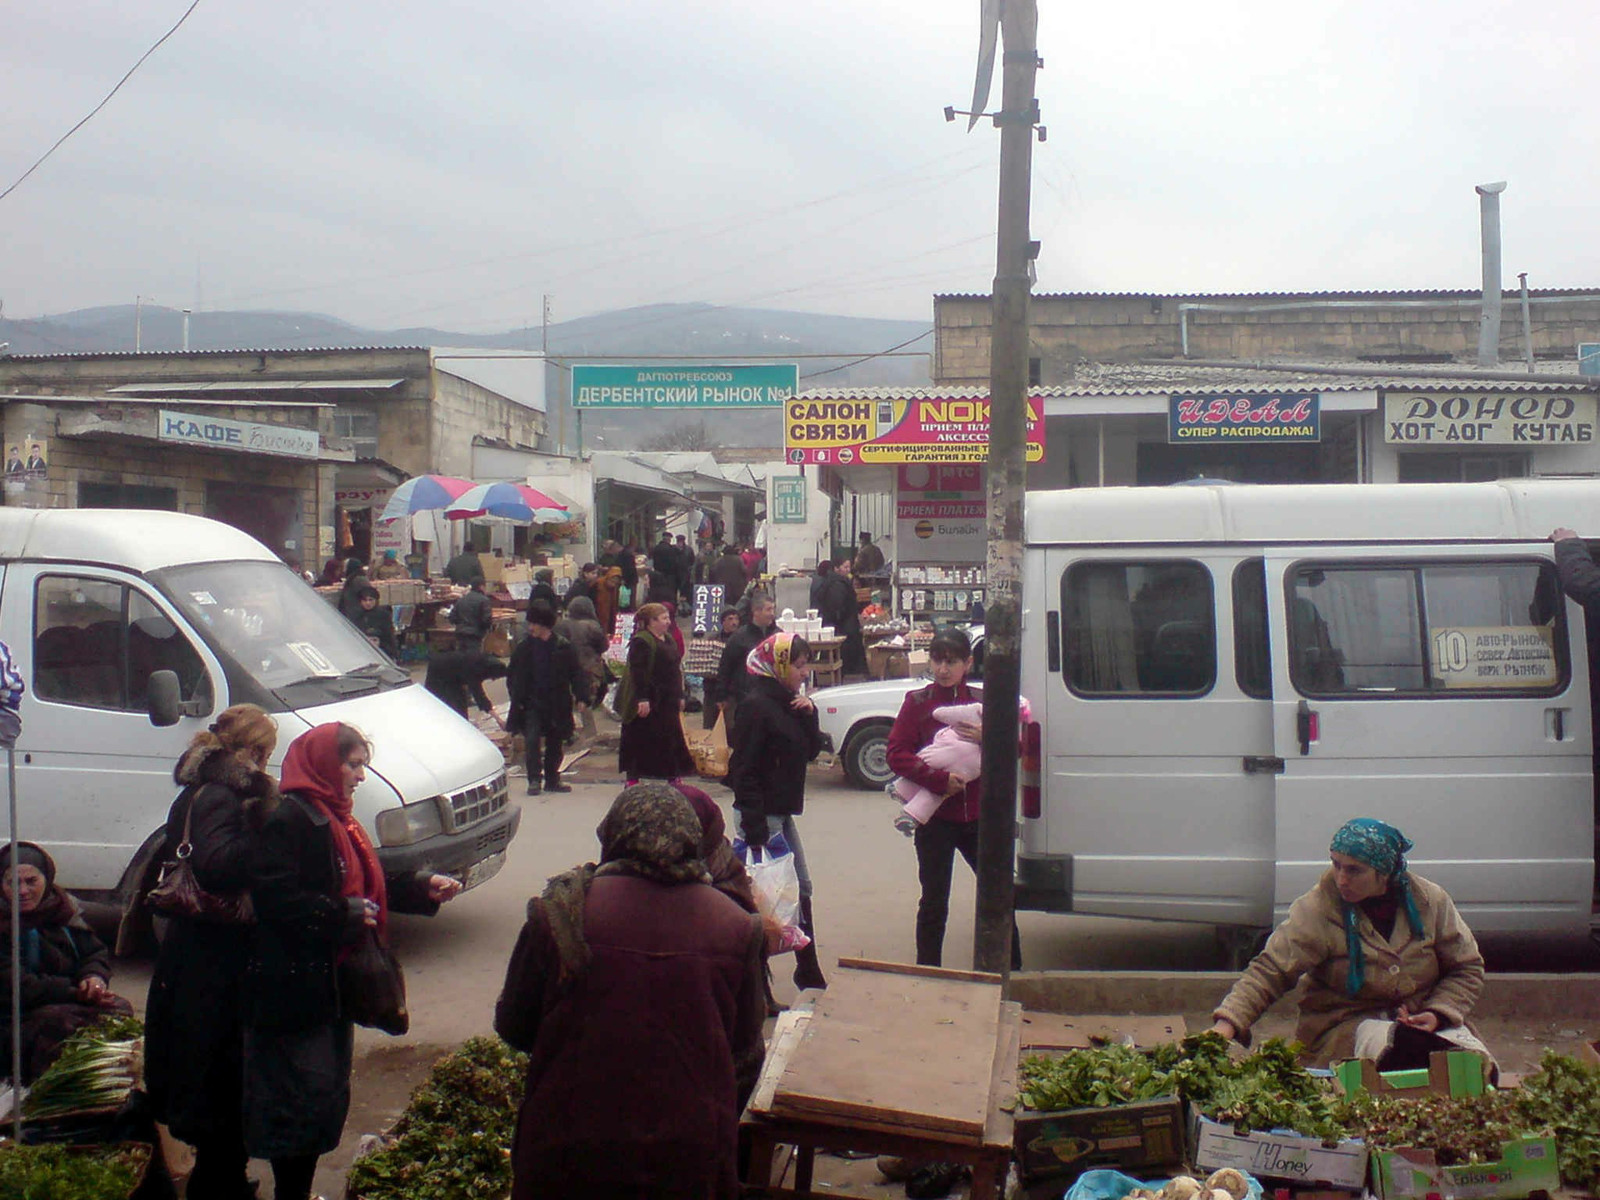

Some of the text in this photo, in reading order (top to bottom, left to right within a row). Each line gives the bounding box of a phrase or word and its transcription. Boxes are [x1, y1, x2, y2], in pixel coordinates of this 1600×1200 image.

[637, 372, 732, 382] ДАГПОТРЕБСОЮЗ
[578, 384, 698, 405] ДЕРБЕНТСКИЙ
[703, 386, 762, 402] РЫНОК
[789, 403, 870, 420] САЛОН
[1178, 397, 1312, 424] ИДЕАЛ
[165, 417, 243, 444] КАФЕ
[789, 423, 868, 440] СВЯЗИ
[921, 423, 963, 432] ПРИЕМ
[1177, 426, 1314, 437] СУПЕР РАСПРОДАЖА!
[1390, 422, 1593, 441] ХОТ-ДОГ КУТАБ
[862, 445, 979, 454] СЕРТИФИЦИРОВАННЫЕ
[905, 453, 958, 461] ГАРАНТИЯ
[969, 453, 989, 462] ГОД
[942, 466, 975, 478] МТС
[898, 504, 987, 516] ПРИЕМ ПЛАТЕЖ
[938, 524, 979, 535] Билайн
[694, 585, 708, 632] АПТЕКА
[1435, 629, 1468, 672] 10
